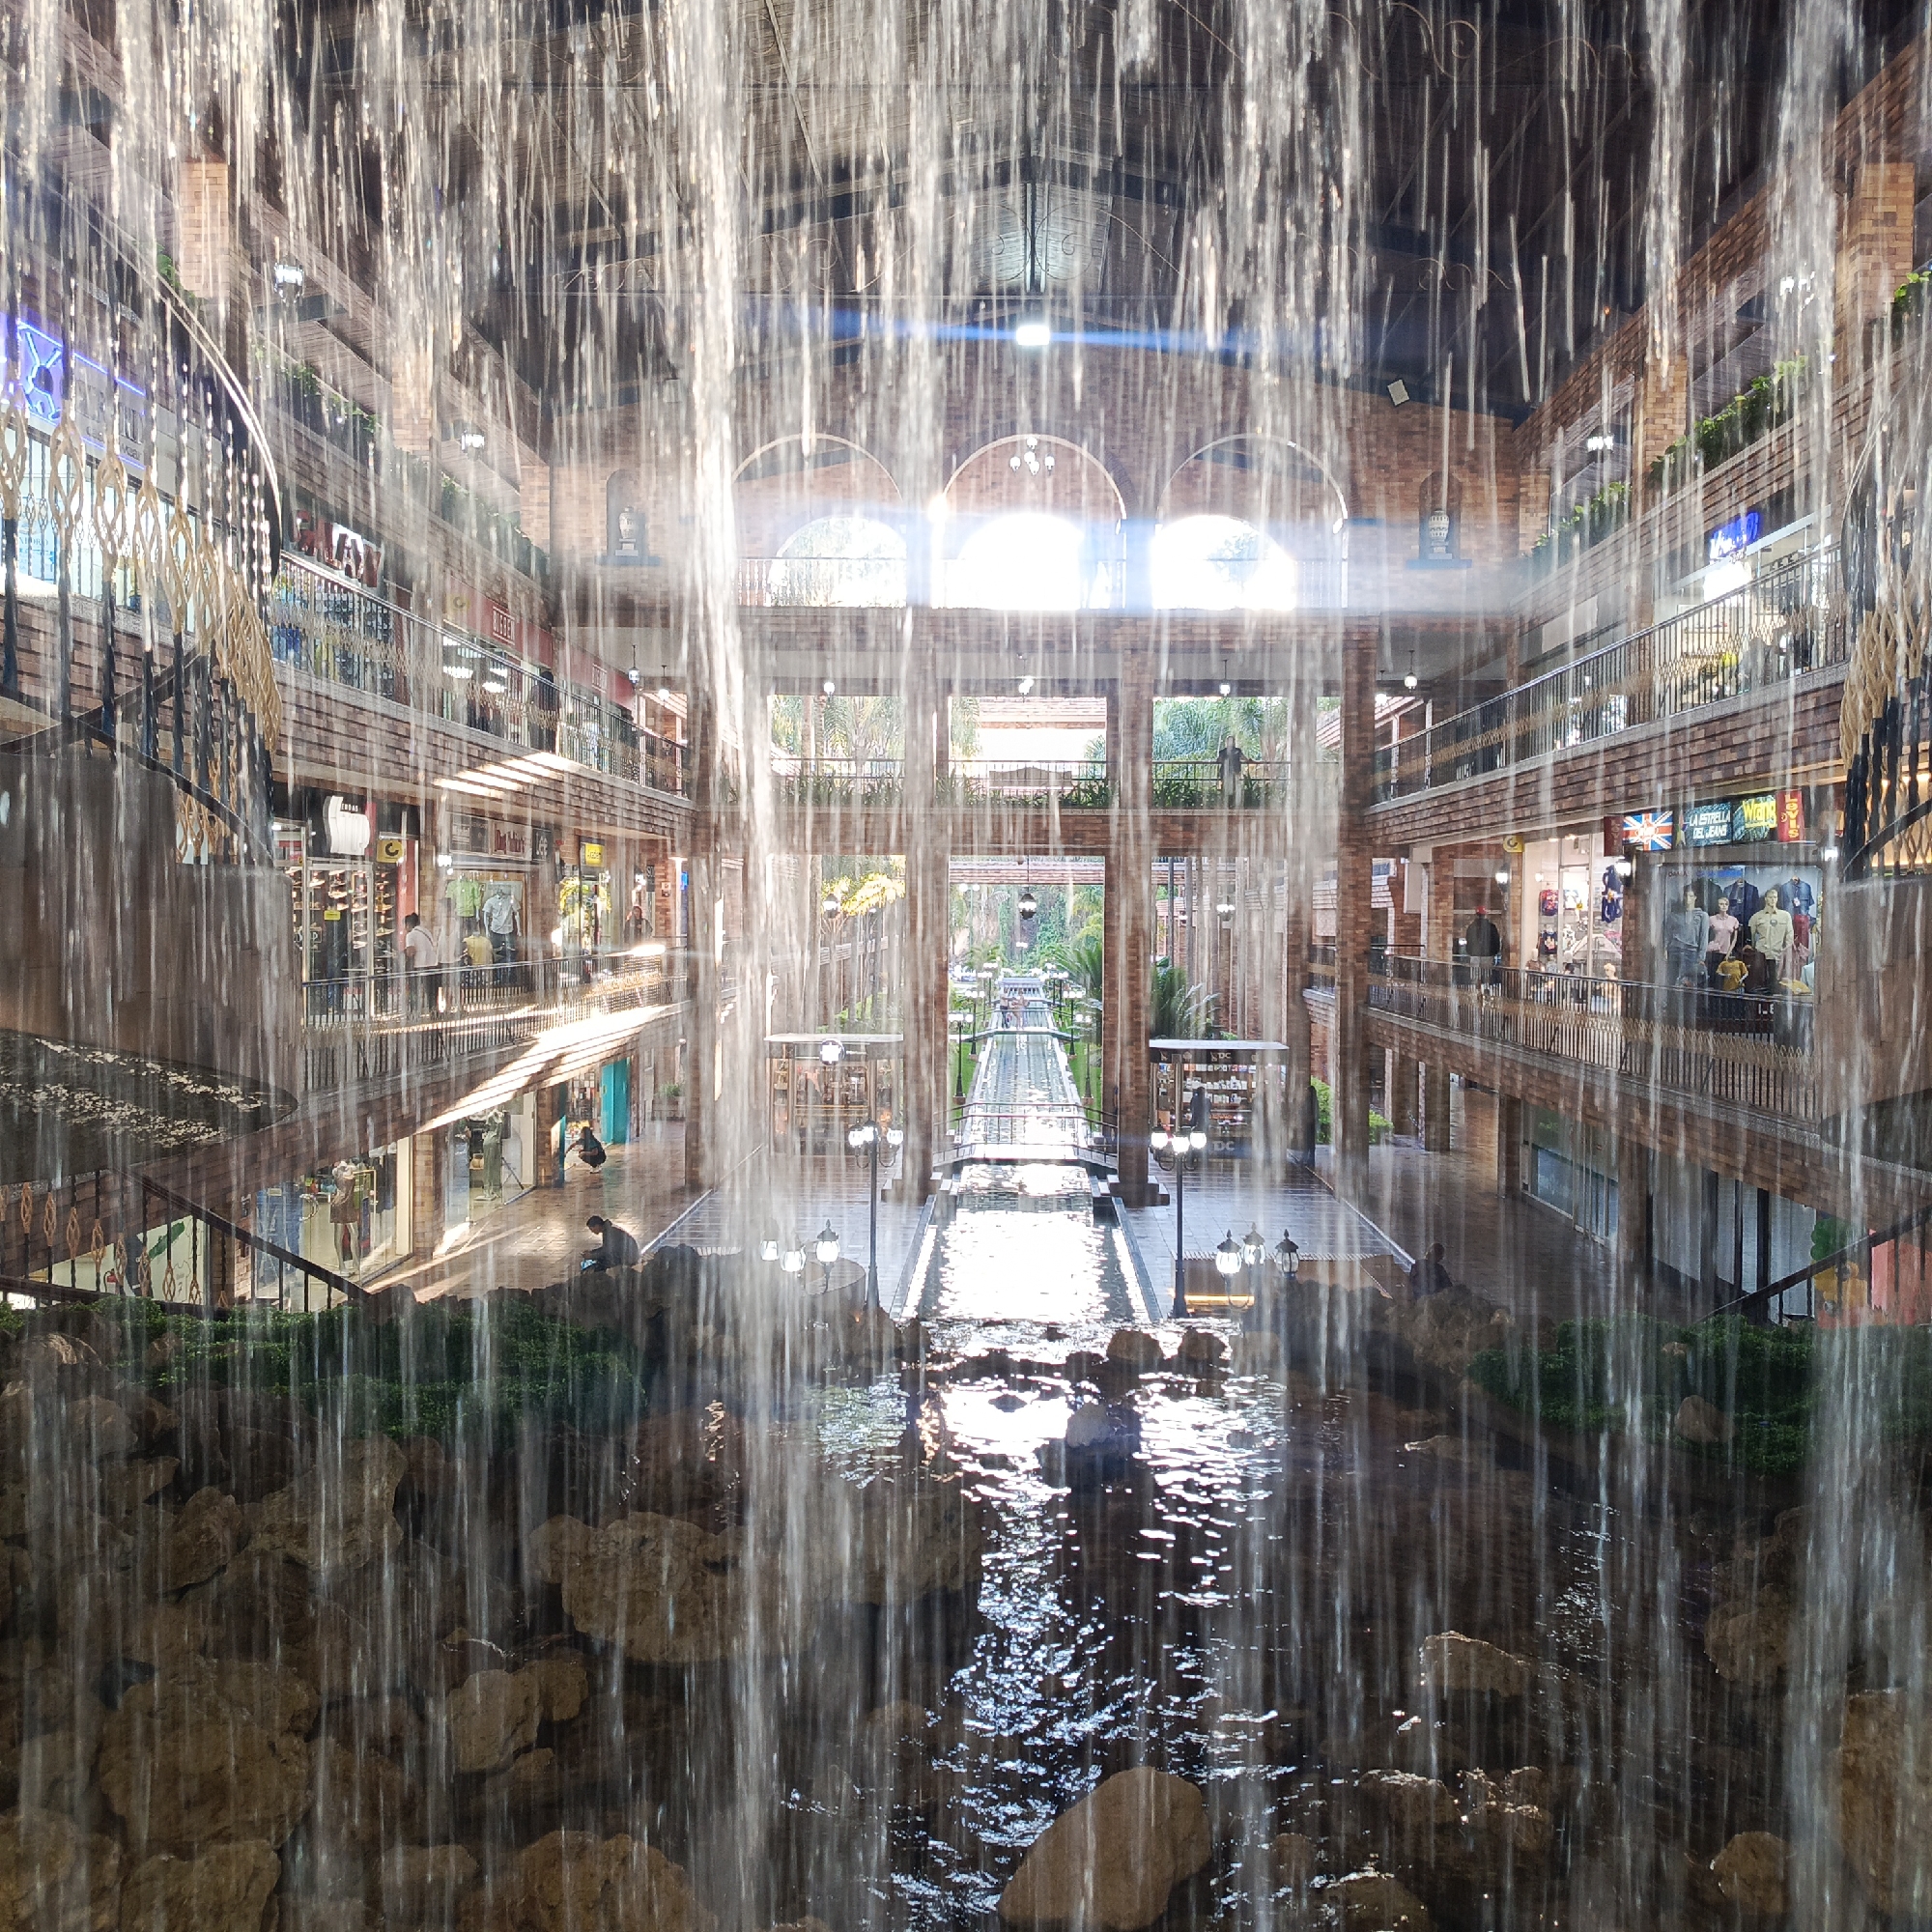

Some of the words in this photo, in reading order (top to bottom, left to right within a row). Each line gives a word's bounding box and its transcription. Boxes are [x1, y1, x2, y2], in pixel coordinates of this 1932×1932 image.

[1690, 814, 1699, 827] LA
[1699, 810, 1731, 825] ESTRELLA
[1692, 827, 1705, 839] DEL
[1705, 824, 1728, 838] JEANS
